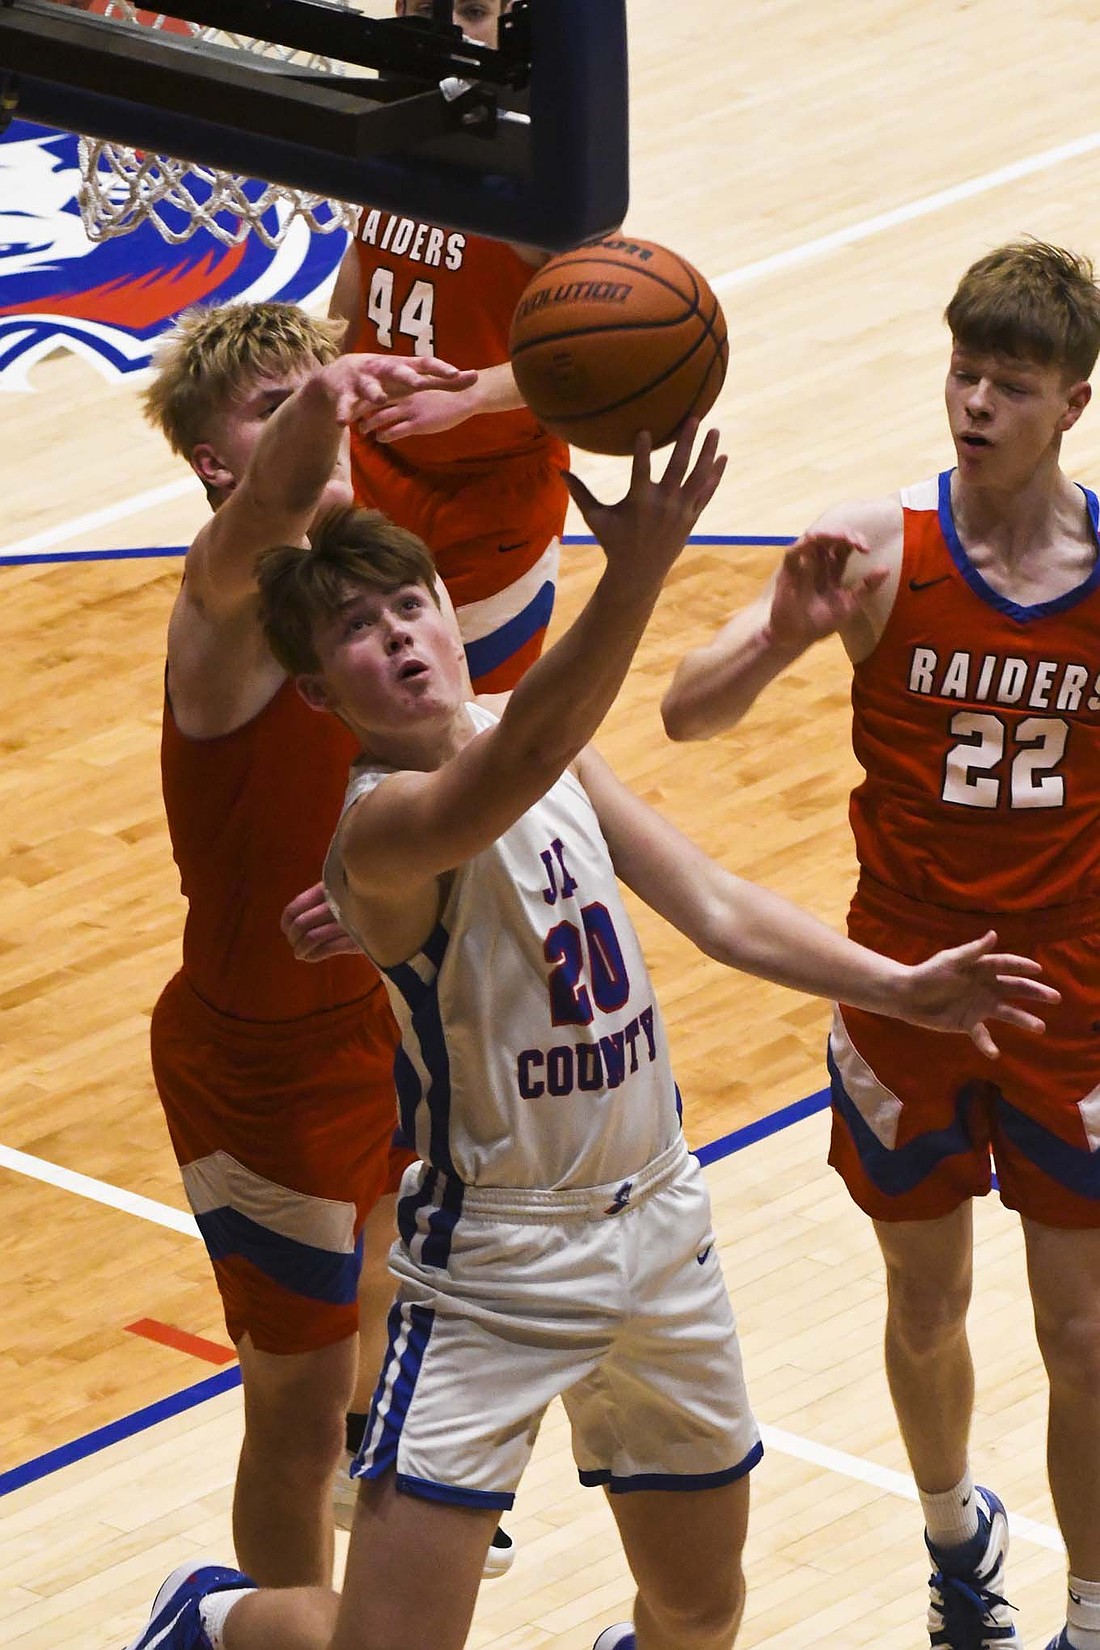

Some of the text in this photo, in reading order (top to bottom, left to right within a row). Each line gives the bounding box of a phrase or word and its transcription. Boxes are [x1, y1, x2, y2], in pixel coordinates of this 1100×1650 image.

[367, 267, 435, 357] 44
[941, 710, 1070, 810] 22
[543, 901, 630, 1028] 20
